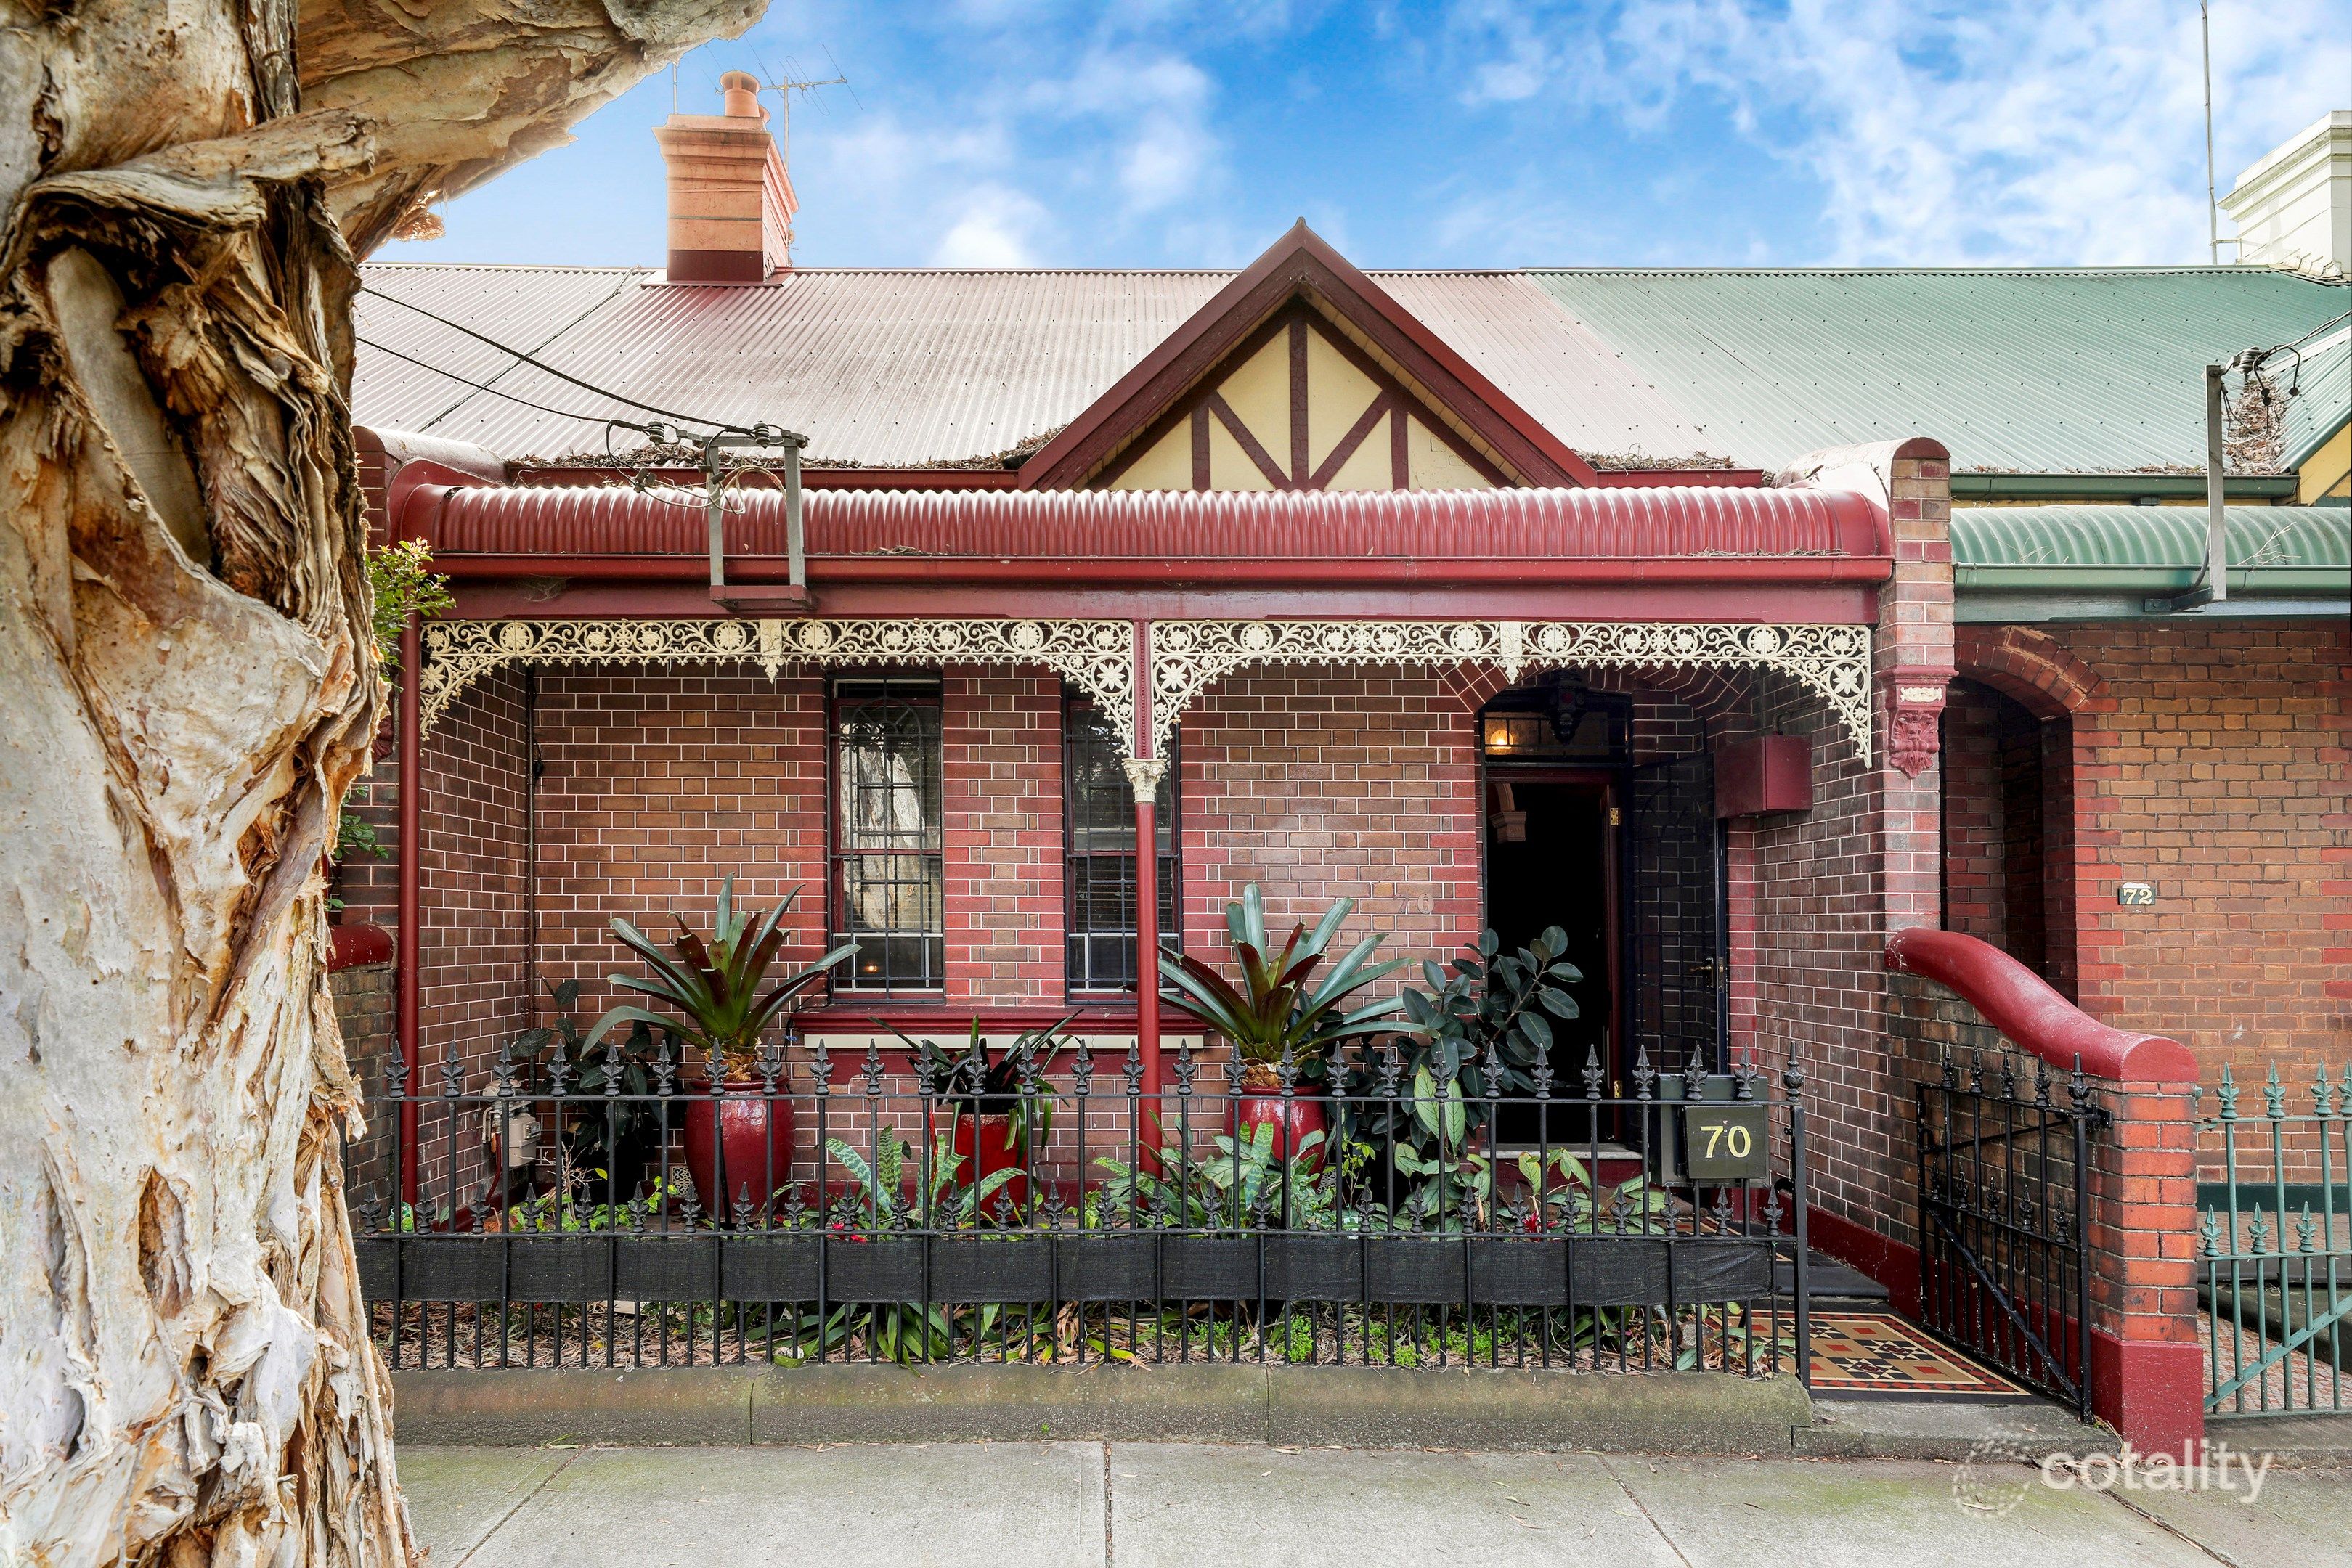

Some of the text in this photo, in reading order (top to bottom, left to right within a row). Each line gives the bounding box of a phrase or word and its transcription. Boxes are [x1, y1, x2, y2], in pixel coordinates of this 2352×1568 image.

[1393, 892, 1435, 915] 70
[2123, 889, 2152, 905] 72
[1700, 1125, 1751, 1159] 70
